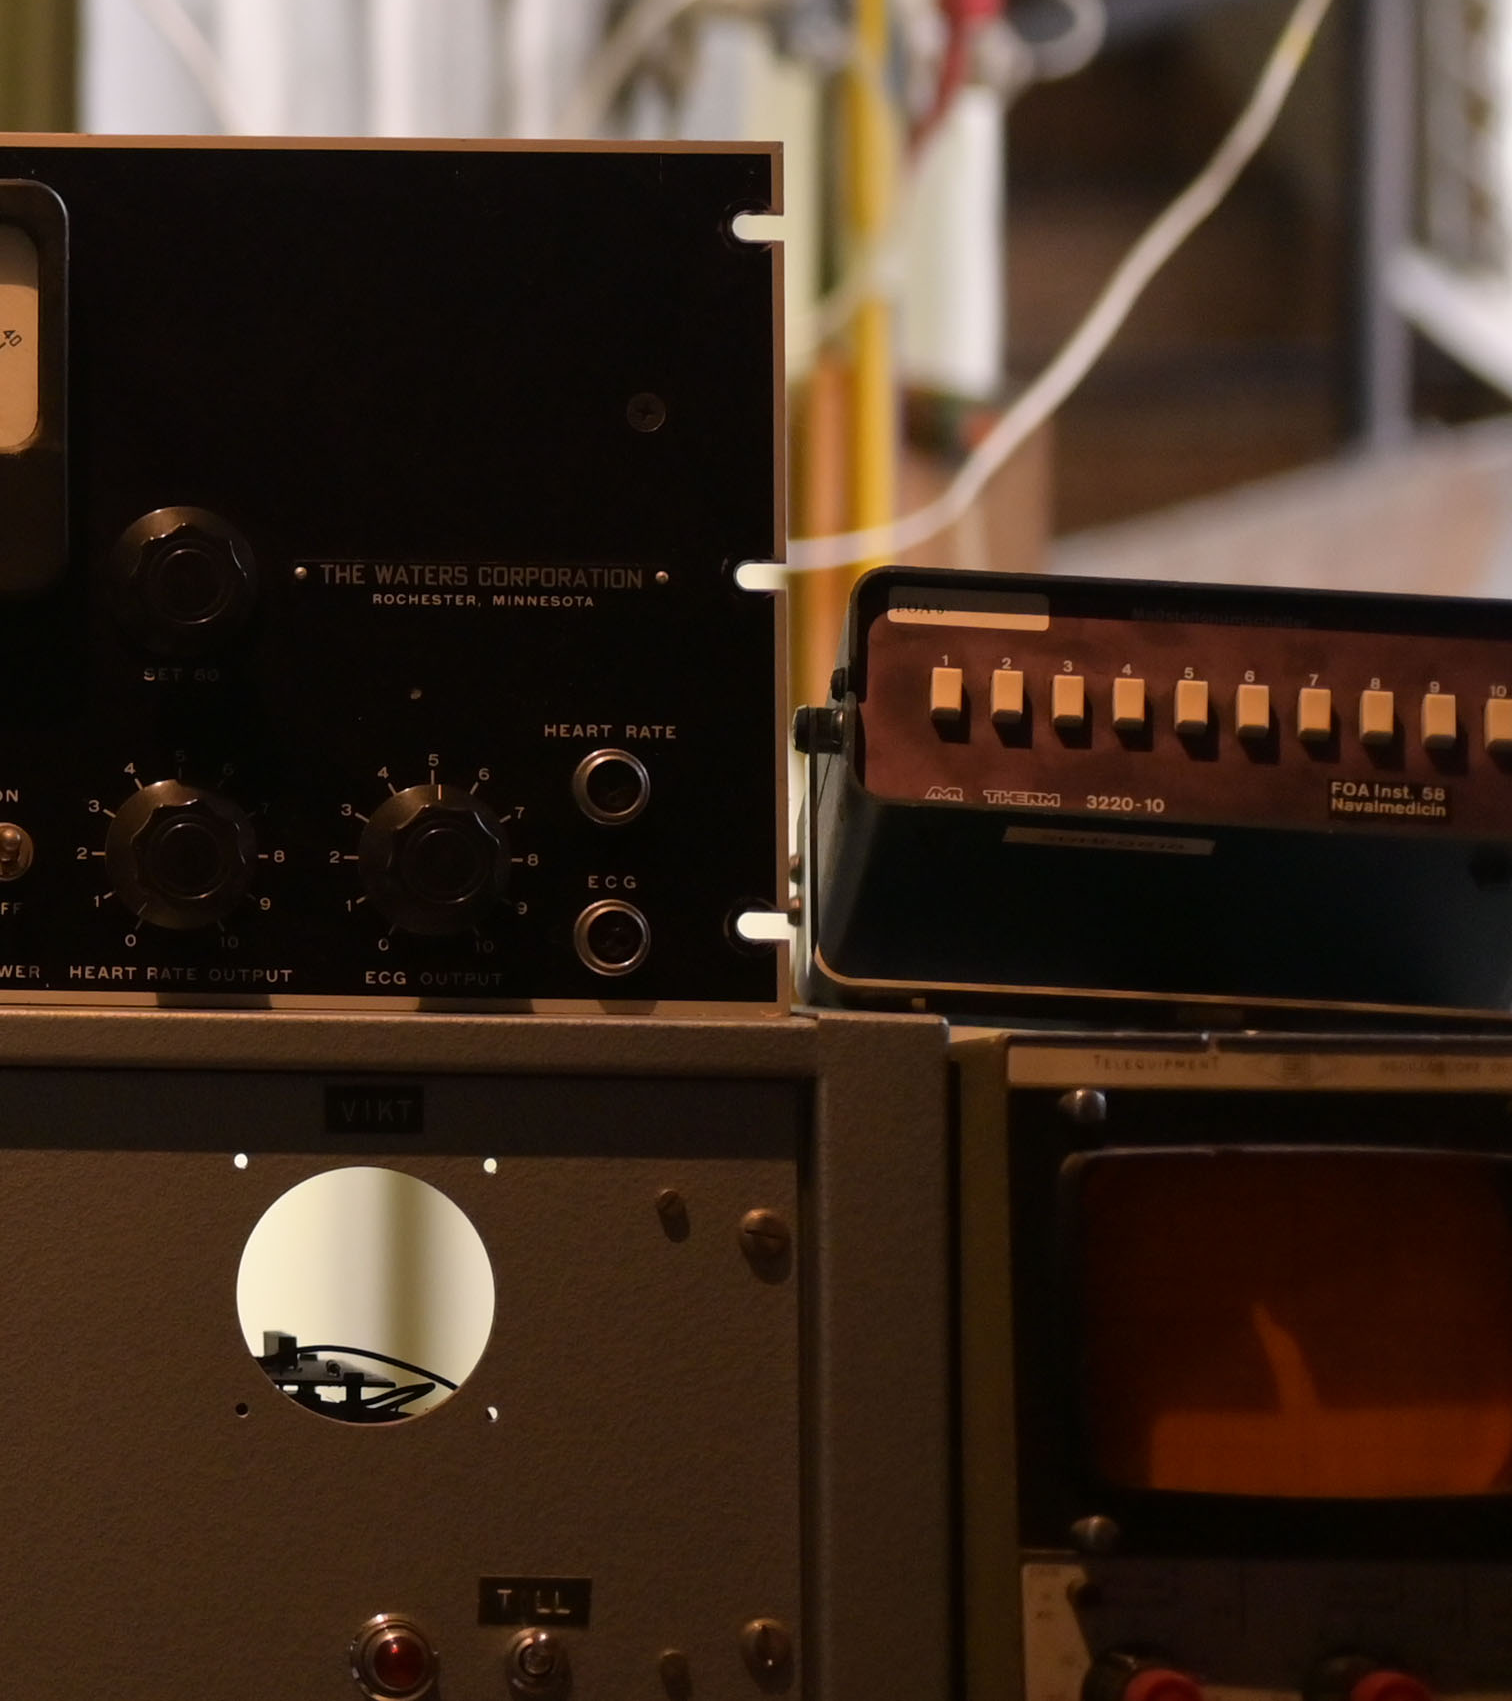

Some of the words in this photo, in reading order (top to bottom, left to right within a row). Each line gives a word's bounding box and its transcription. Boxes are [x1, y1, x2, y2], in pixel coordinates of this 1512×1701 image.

[321, 564, 365, 586] THE
[375, 565, 469, 588] WATERS
[478, 565, 643, 589] CORPORATION
[372, 593, 482, 610] ROCHESTER,
[492, 594, 594, 607] MINNESOTA
[544, 723, 613, 738] HEART
[625, 724, 677, 739] RATE
[1330, 781, 1369, 798] FOA
[1372, 783, 1414, 800] Inst.
[1421, 786, 1446, 802] 58
[983, 790, 1060, 807] THERM
[1086, 796, 1165, 814] 3220-10
[1330, 799, 1446, 817] Navalmedicin
[587, 875, 637, 890] ECG
[69, 964, 137, 980] HEART
[146, 966, 198, 981] RATE
[207, 968, 293, 983] OUTPUT
[364, 971, 406, 985] ECG
[420, 971, 503, 986] OUTPUT
[341, 1097, 415, 1124] VIKT
